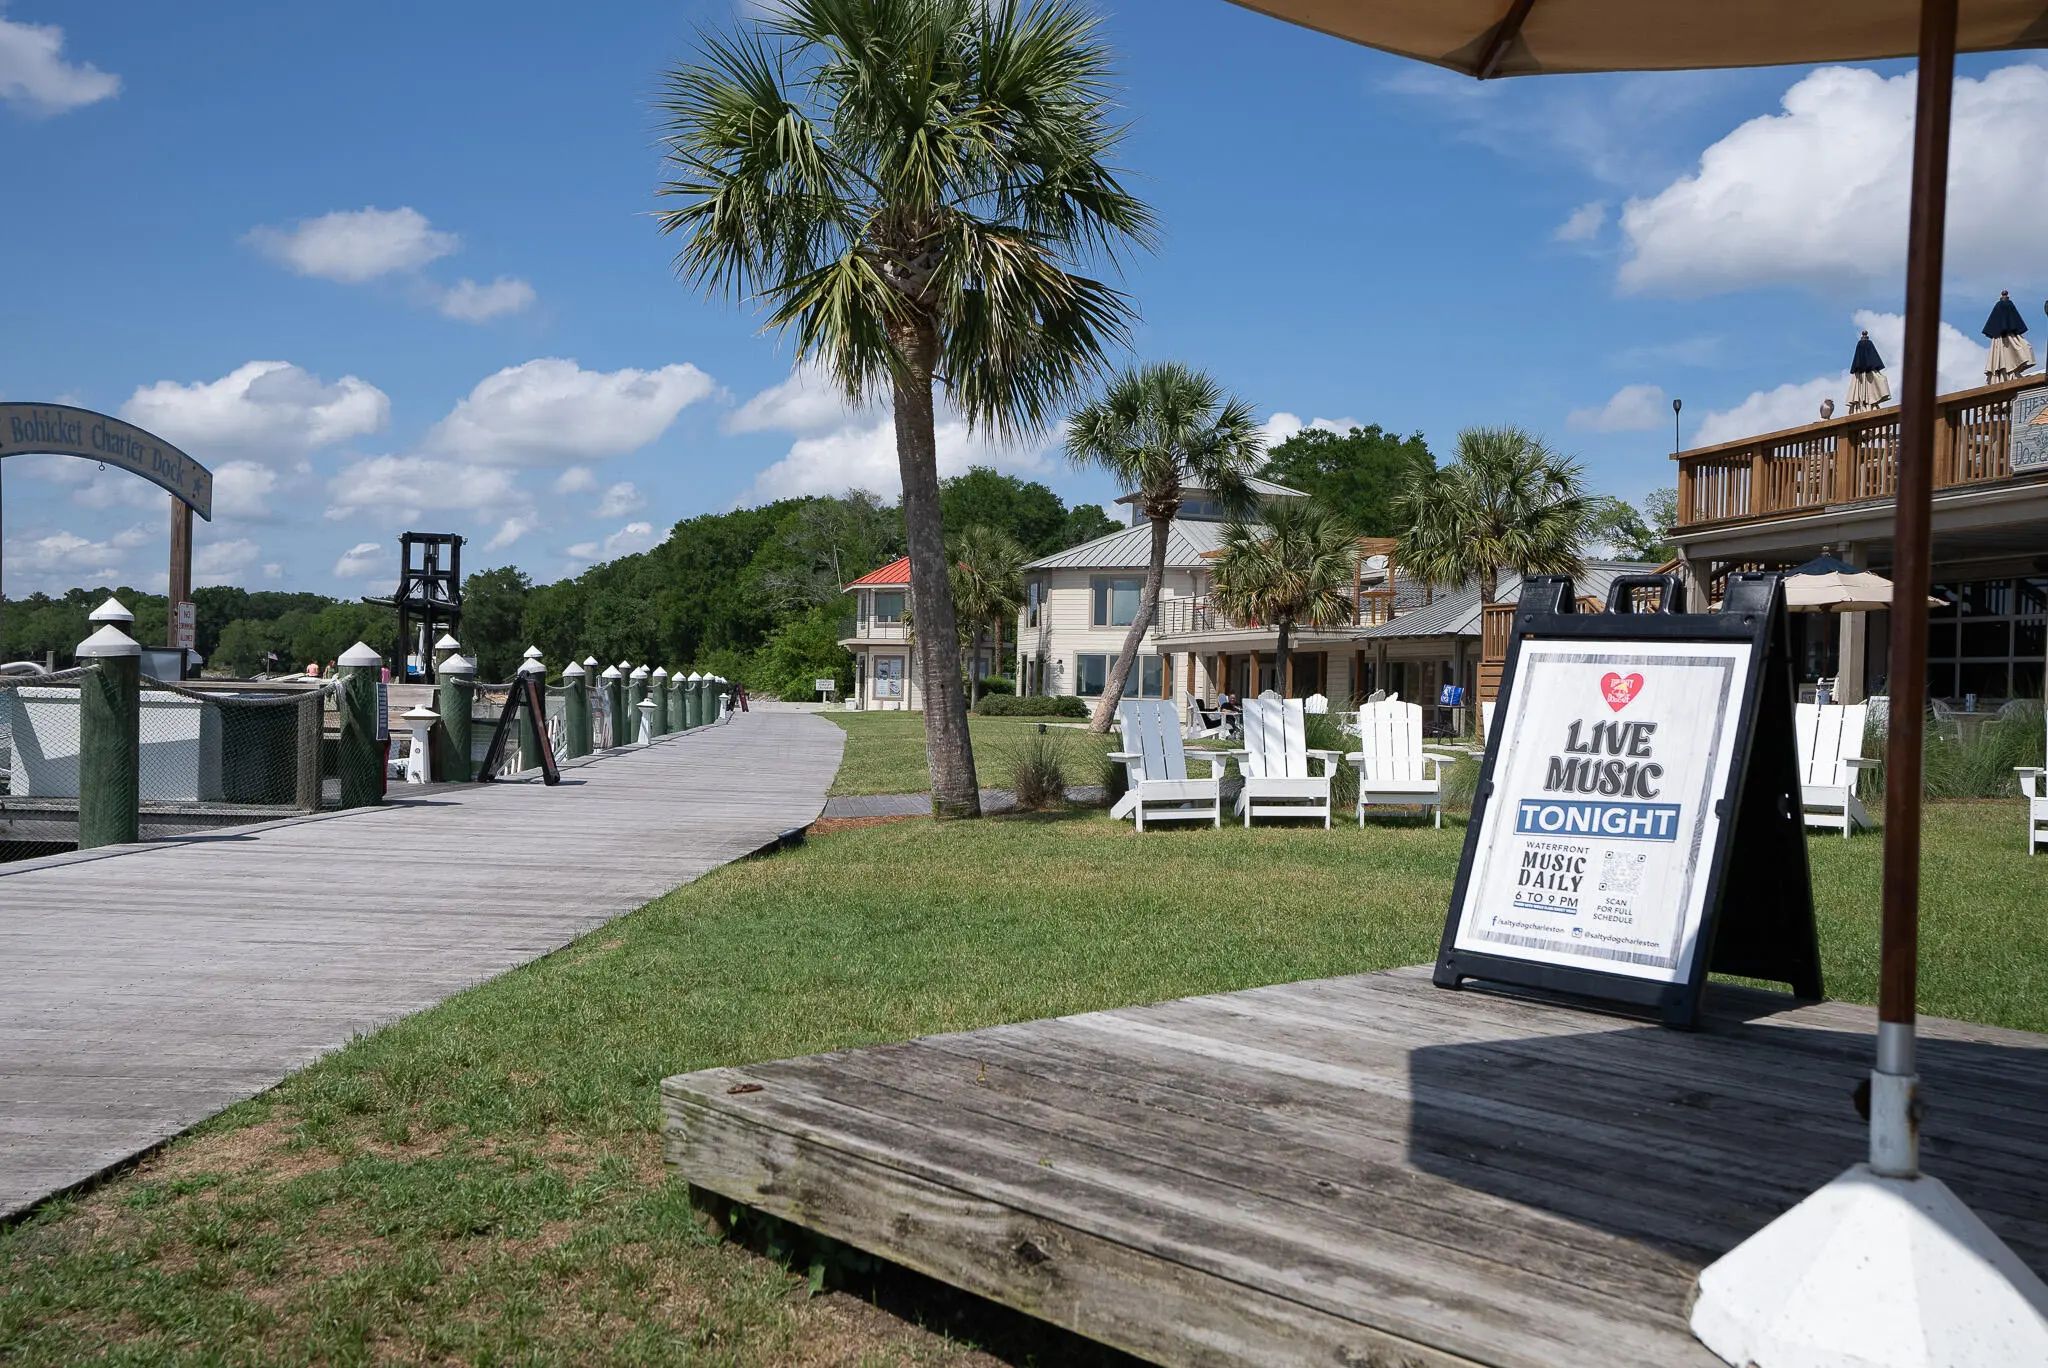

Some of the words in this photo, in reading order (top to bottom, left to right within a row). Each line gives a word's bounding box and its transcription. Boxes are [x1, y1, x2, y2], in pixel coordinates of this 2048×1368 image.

[11, 410, 82, 446] Bohicket
[92, 419, 144, 464] Charter
[152, 448, 184, 486] Dock
[1564, 719, 1657, 758] LIVE
[1543, 756, 1664, 800] MUSIC
[1520, 804, 1677, 836] TONIGHT
[1526, 841, 1590, 854] WATERFRONT
[1521, 850, 1587, 874] MUSIC
[1518, 868, 1584, 893] DAILY
[1515, 891, 1522, 900] 6
[1527, 892, 1543, 903] TO
[1548, 894, 1555, 904] 9
[1559, 896, 1579, 908] PM
[1597, 905, 1613, 913] FOR
[1614, 907, 1632, 916] FULL
[1605, 897, 1627, 906] SCAN
[1592, 912, 1632, 924] SCHEDULE
